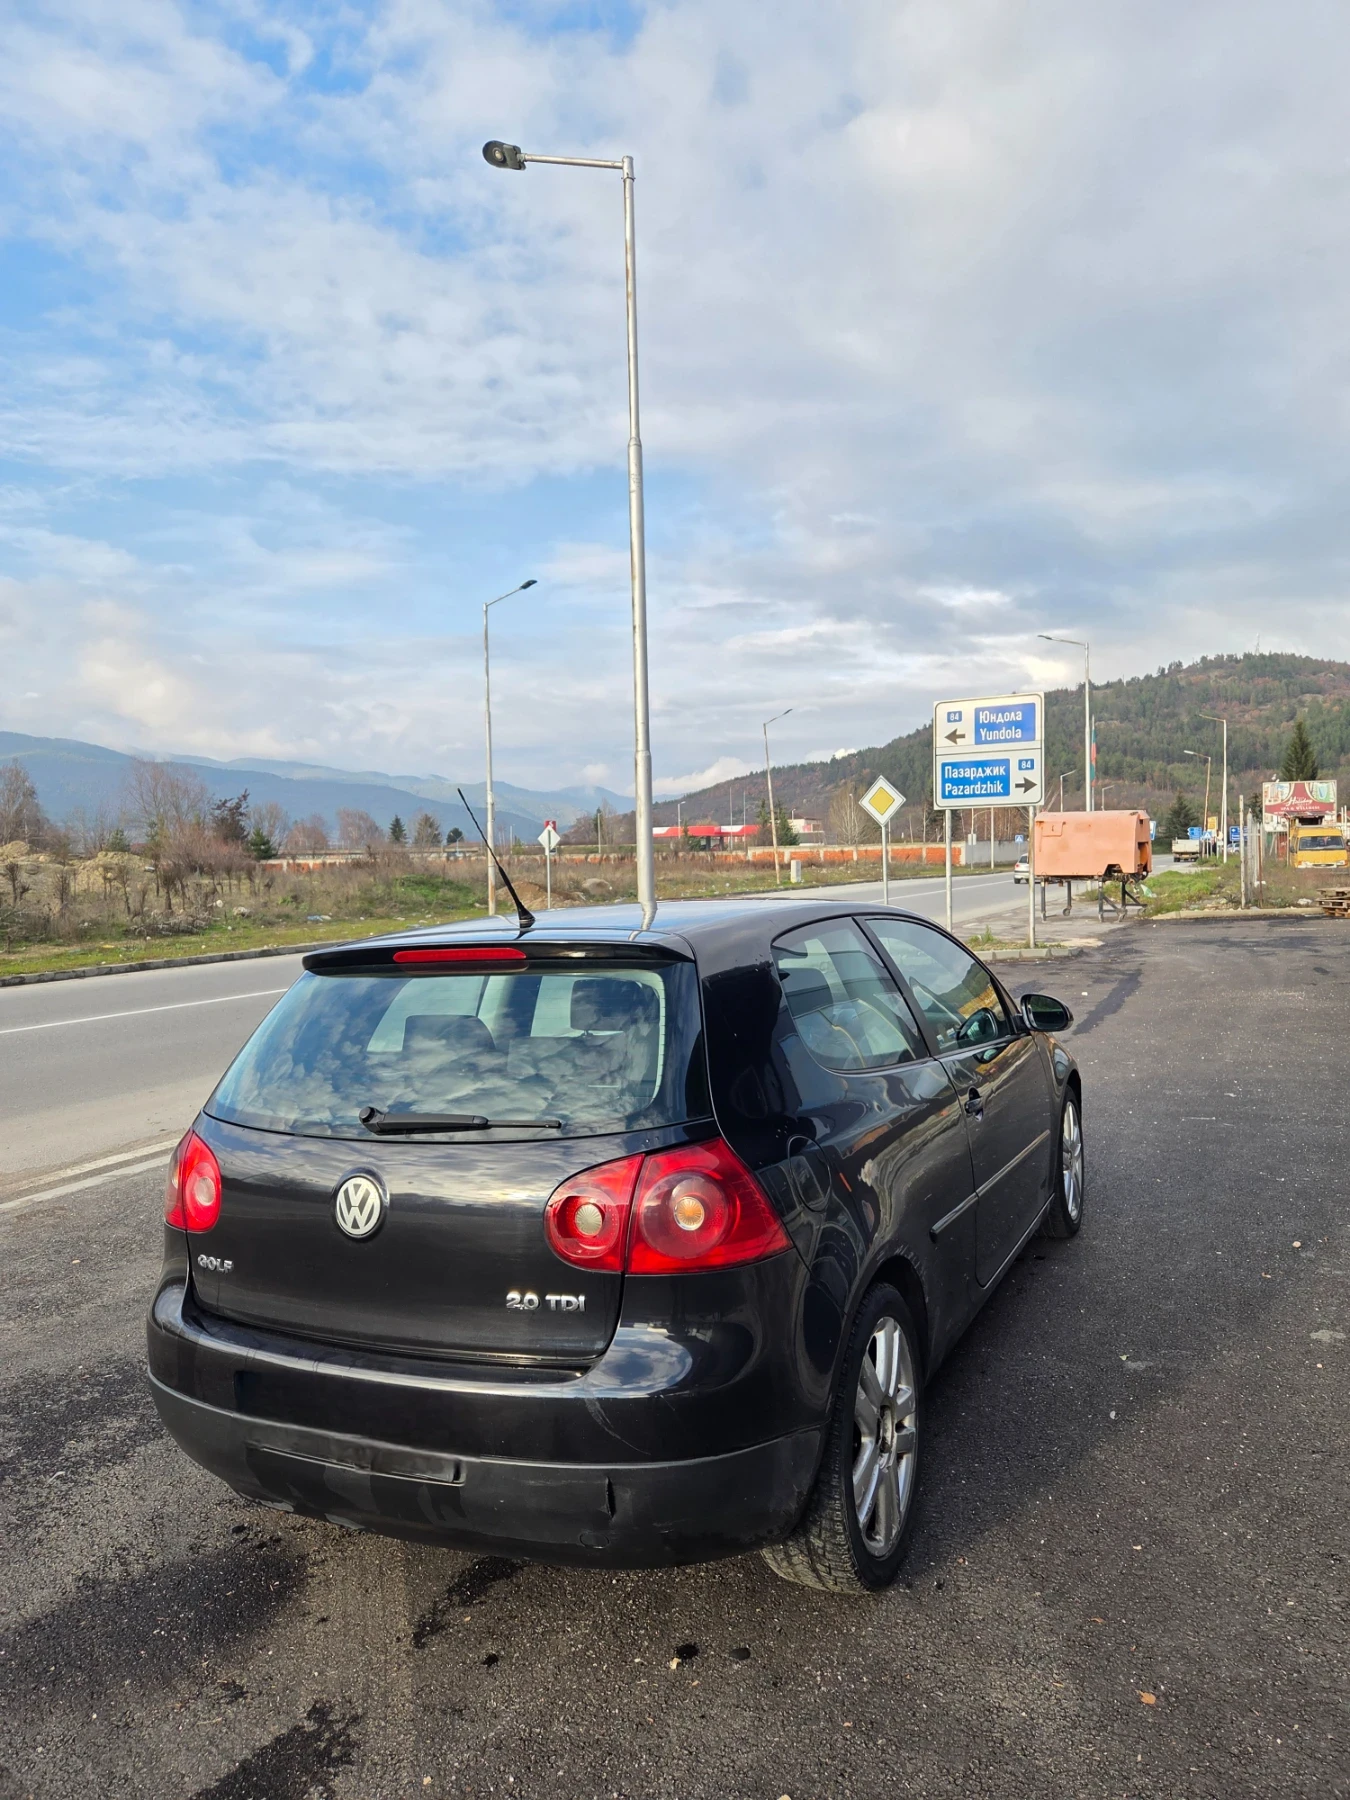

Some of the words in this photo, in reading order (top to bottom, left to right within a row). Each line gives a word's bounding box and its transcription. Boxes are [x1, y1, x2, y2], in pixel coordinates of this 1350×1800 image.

[949, 713, 959, 721] 84
[979, 710, 1022, 724] Юндола
[980, 726, 1022, 741] Yundola
[1021, 760, 1031, 769] 84
[944, 765, 1006, 780] Пазарджик
[945, 781, 1004, 796] Pazardzhik
[197, 1254, 234, 1273] GOLF
[506, 1290, 540, 1310] 2.0
[545, 1294, 586, 1311] TDI
